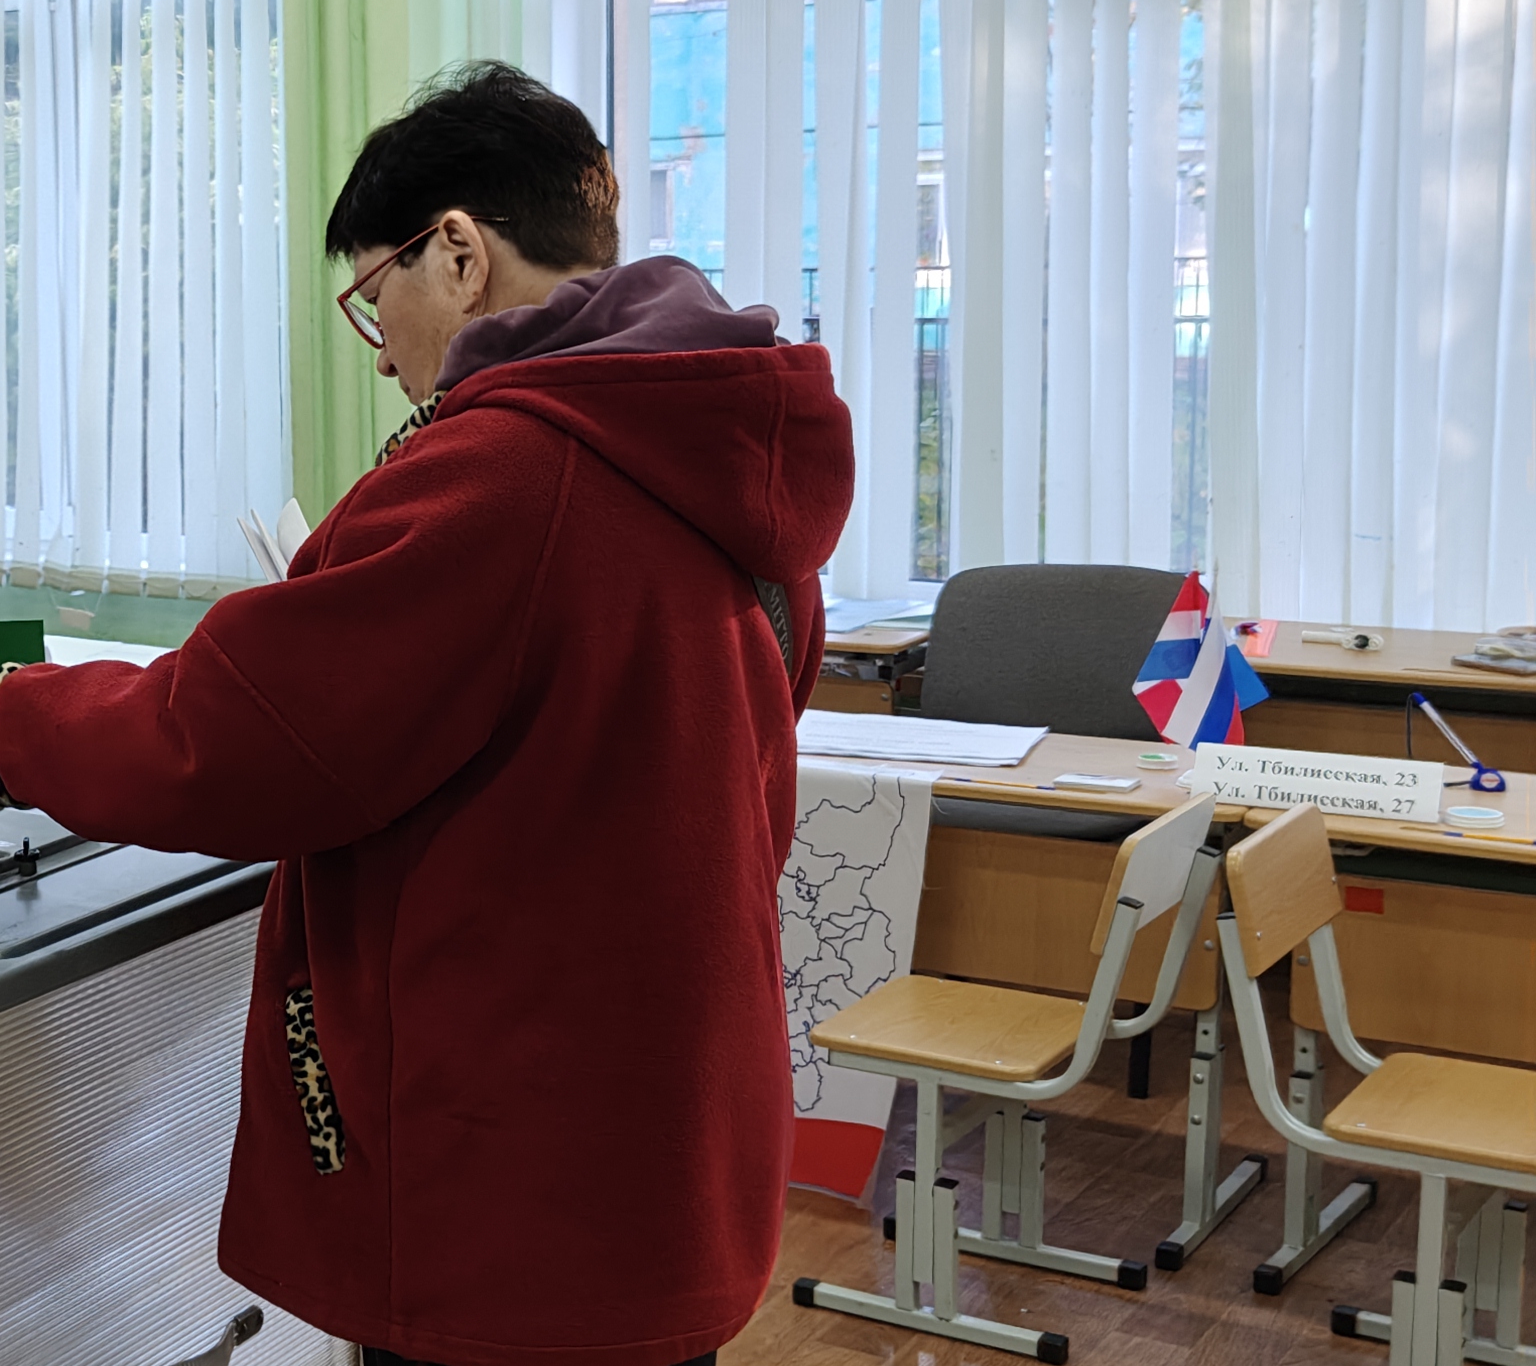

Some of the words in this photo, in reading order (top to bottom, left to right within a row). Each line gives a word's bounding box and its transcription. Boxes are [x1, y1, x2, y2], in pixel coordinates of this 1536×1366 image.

[1216, 755, 1249, 773] Ул.
[1257, 758, 1388, 787] Тбилисская,
[1394, 772, 1418, 788] 23
[1213, 781, 1247, 798] Ул.
[1253, 784, 1385, 813] Тбилисская,
[1391, 798, 1416, 814] 27
